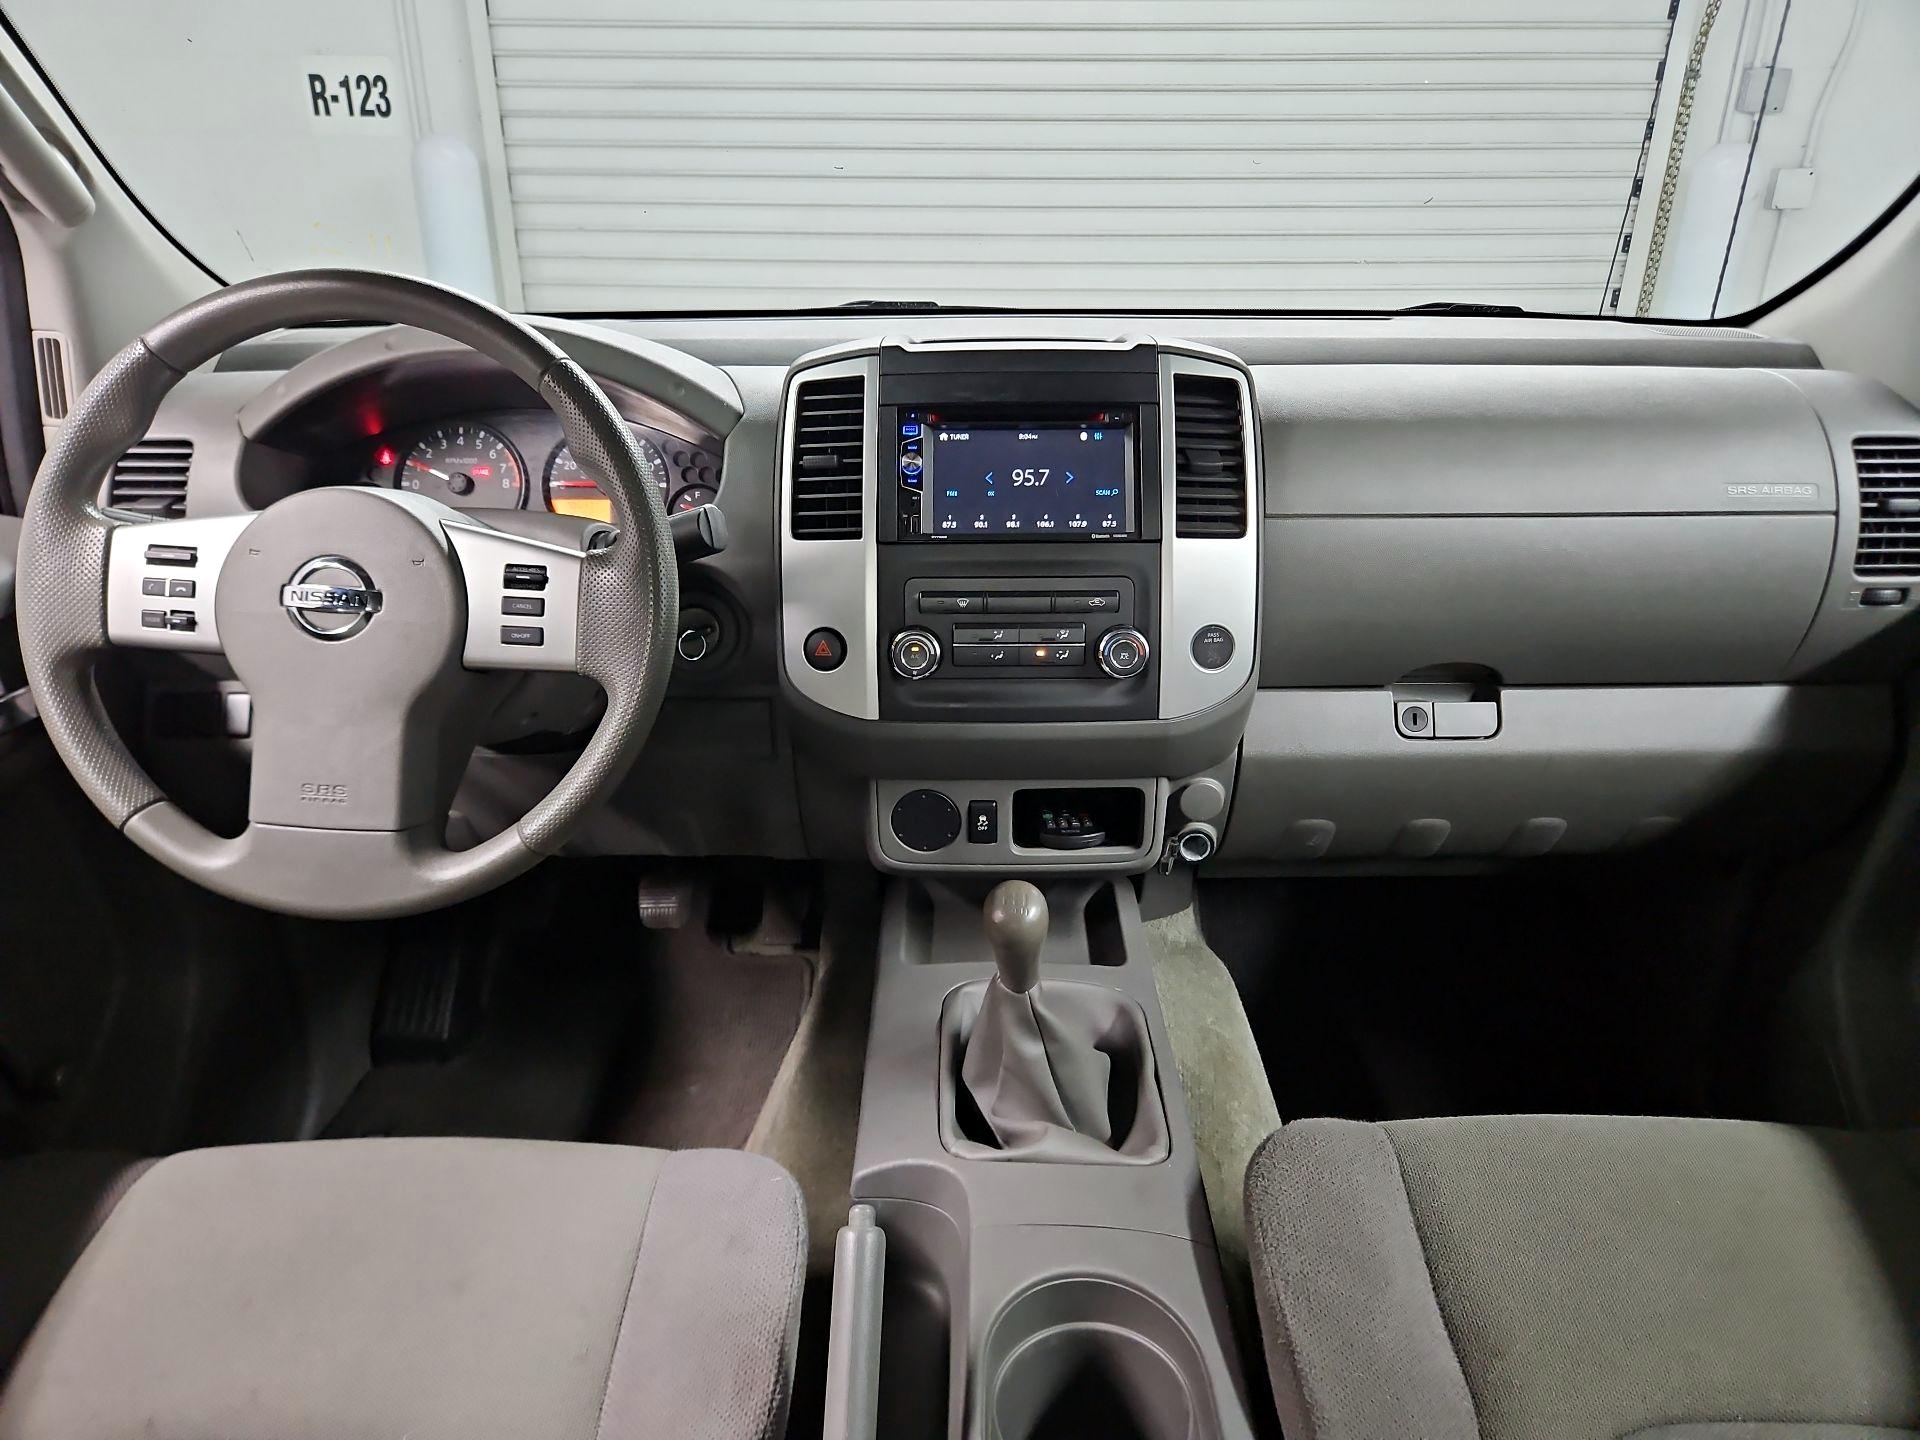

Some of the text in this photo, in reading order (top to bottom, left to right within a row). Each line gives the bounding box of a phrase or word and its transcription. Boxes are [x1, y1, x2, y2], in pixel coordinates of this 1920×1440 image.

[308, 73, 392, 118] R-123
[441, 439, 448, 450] 3
[456, 436, 465, 446] 4
[475, 439, 483, 450] 5
[425, 448, 433, 459] 2
[490, 449, 497, 460] 6
[499, 463, 507, 474] 7
[563, 461, 577, 471] 20
[1011, 468, 1050, 487] 95.7
[411, 480, 420, 490] 0
[501, 479, 510, 489] 8
[694, 491, 701, 499] F
[1095, 488, 1111, 496] SCAN
[1727, 485, 1812, 496] SRS AIRBAG
[290, 589, 371, 608] NISSAN
[511, 602, 533, 610] CANCEL
[301, 782, 347, 797] SRS
